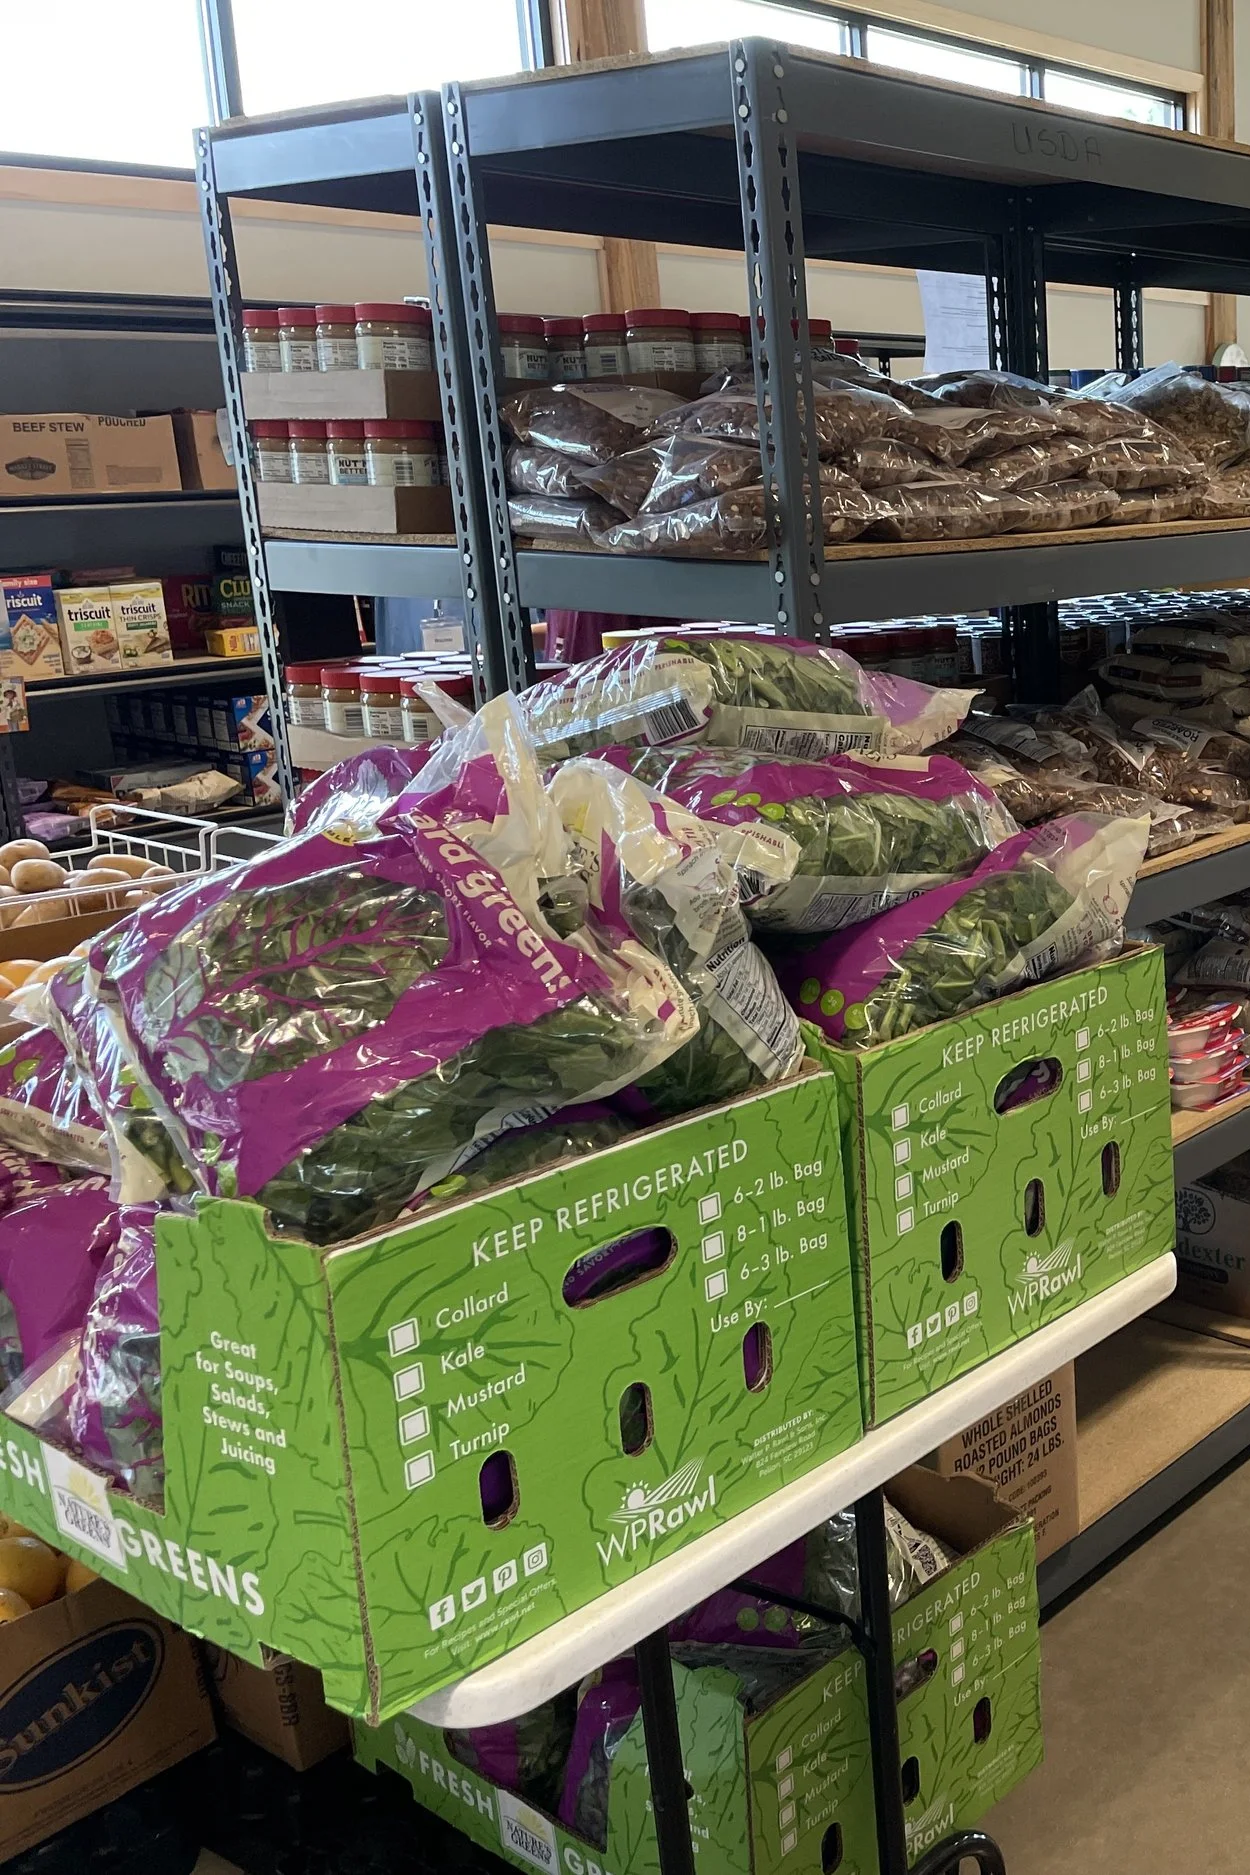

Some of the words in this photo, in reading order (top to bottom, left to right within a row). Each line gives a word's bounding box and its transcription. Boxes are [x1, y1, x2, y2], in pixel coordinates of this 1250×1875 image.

[1011, 122, 1101, 165] USDA
[13, 422, 46, 433] BEEF
[50, 422, 85, 432] STEW
[6, 593, 43, 609] riscuit
[182, 584, 209, 608] RIT
[220, 579, 251, 598] CLU
[68, 606, 111, 621] triscuit
[121, 603, 157, 615] triscuit
[463, 909, 493, 950] FLAVOR
[706, 936, 746, 974] Nutrition
[942, 1033, 985, 1069] KEEP
[991, 986, 1109, 1048] REFRIGERATED
[1119, 1011, 1132, 1029] lb.
[1136, 1006, 1155, 1025] Bag
[1120, 1043, 1134, 1061] lb.
[1137, 1036, 1156, 1055] Bag
[1122, 1074, 1134, 1092] lb.
[1138, 1066, 1157, 1084] Bag
[919, 1082, 962, 1115] Collard
[920, 1127, 947, 1149] Kale
[1080, 1121, 1098, 1140] Use
[769, 1169, 789, 1191] lb.
[794, 1157, 823, 1181] Bag
[922, 1150, 970, 1185] Mustard
[472, 1219, 544, 1268] KEEP
[558, 1139, 750, 1233] REFRIGERATED
[772, 1206, 792, 1230] lb.
[797, 1194, 826, 1219] Bag
[923, 1191, 960, 1219] Turnip
[775, 1243, 794, 1266] lb.
[799, 1231, 829, 1255] Bag
[1178, 1236, 1246, 1271] dexter
[1008, 1254, 1083, 1317] WPRawl
[435, 1283, 509, 1331] Collard
[711, 1308, 739, 1333] Use
[211, 1331, 257, 1360] Great
[440, 1342, 486, 1375] Kale
[195, 1351, 220, 1374] for
[224, 1360, 279, 1396] Soups,
[446, 1363, 527, 1417] Mustard
[211, 1383, 270, 1419] Salads,
[961, 1406, 1004, 1449] WHOLE
[1006, 1379, 1053, 1422] SHELLED
[202, 1406, 250, 1437] Stews
[255, 1427, 287, 1448] and
[449, 1419, 510, 1461] Turnip
[754, 1415, 802, 1447] DISTRIBUTED
[954, 1430, 1007, 1473] ROASTED
[1010, 1393, 1062, 1440] ALMONDS
[221, 1437, 276, 1476] Juicing
[989, 1437, 1027, 1475] POUND
[1029, 1416, 1058, 1446] BAGS
[1027, 1450, 1040, 1470] 24
[1042, 1432, 1065, 1458] LBS.
[596, 1475, 717, 1567] WPRawl
[115, 1518, 265, 1616] GREENS
[1007, 1571, 1025, 1590] Bag
[892, 1571, 981, 1644] RIGERATED
[1007, 1596, 1026, 1614] Bag
[424, 1644, 440, 1660] For
[442, 1624, 477, 1647] Recipes
[478, 1613, 496, 1630] and
[497, 1594, 529, 1617] Special
[1008, 1620, 1027, 1639] Bag
[823, 1660, 862, 1703] KEEP
[954, 1688, 972, 1707] Use
[801, 1708, 842, 1748] Collard
[802, 1751, 828, 1777] Kale
[804, 1757, 849, 1805] Mustard
[419, 1750, 494, 1822] FRESH
[805, 1799, 839, 1830] Turnip
[507, 1819, 552, 1856] NATURE'S
[511, 1832, 552, 1865] GREENS
